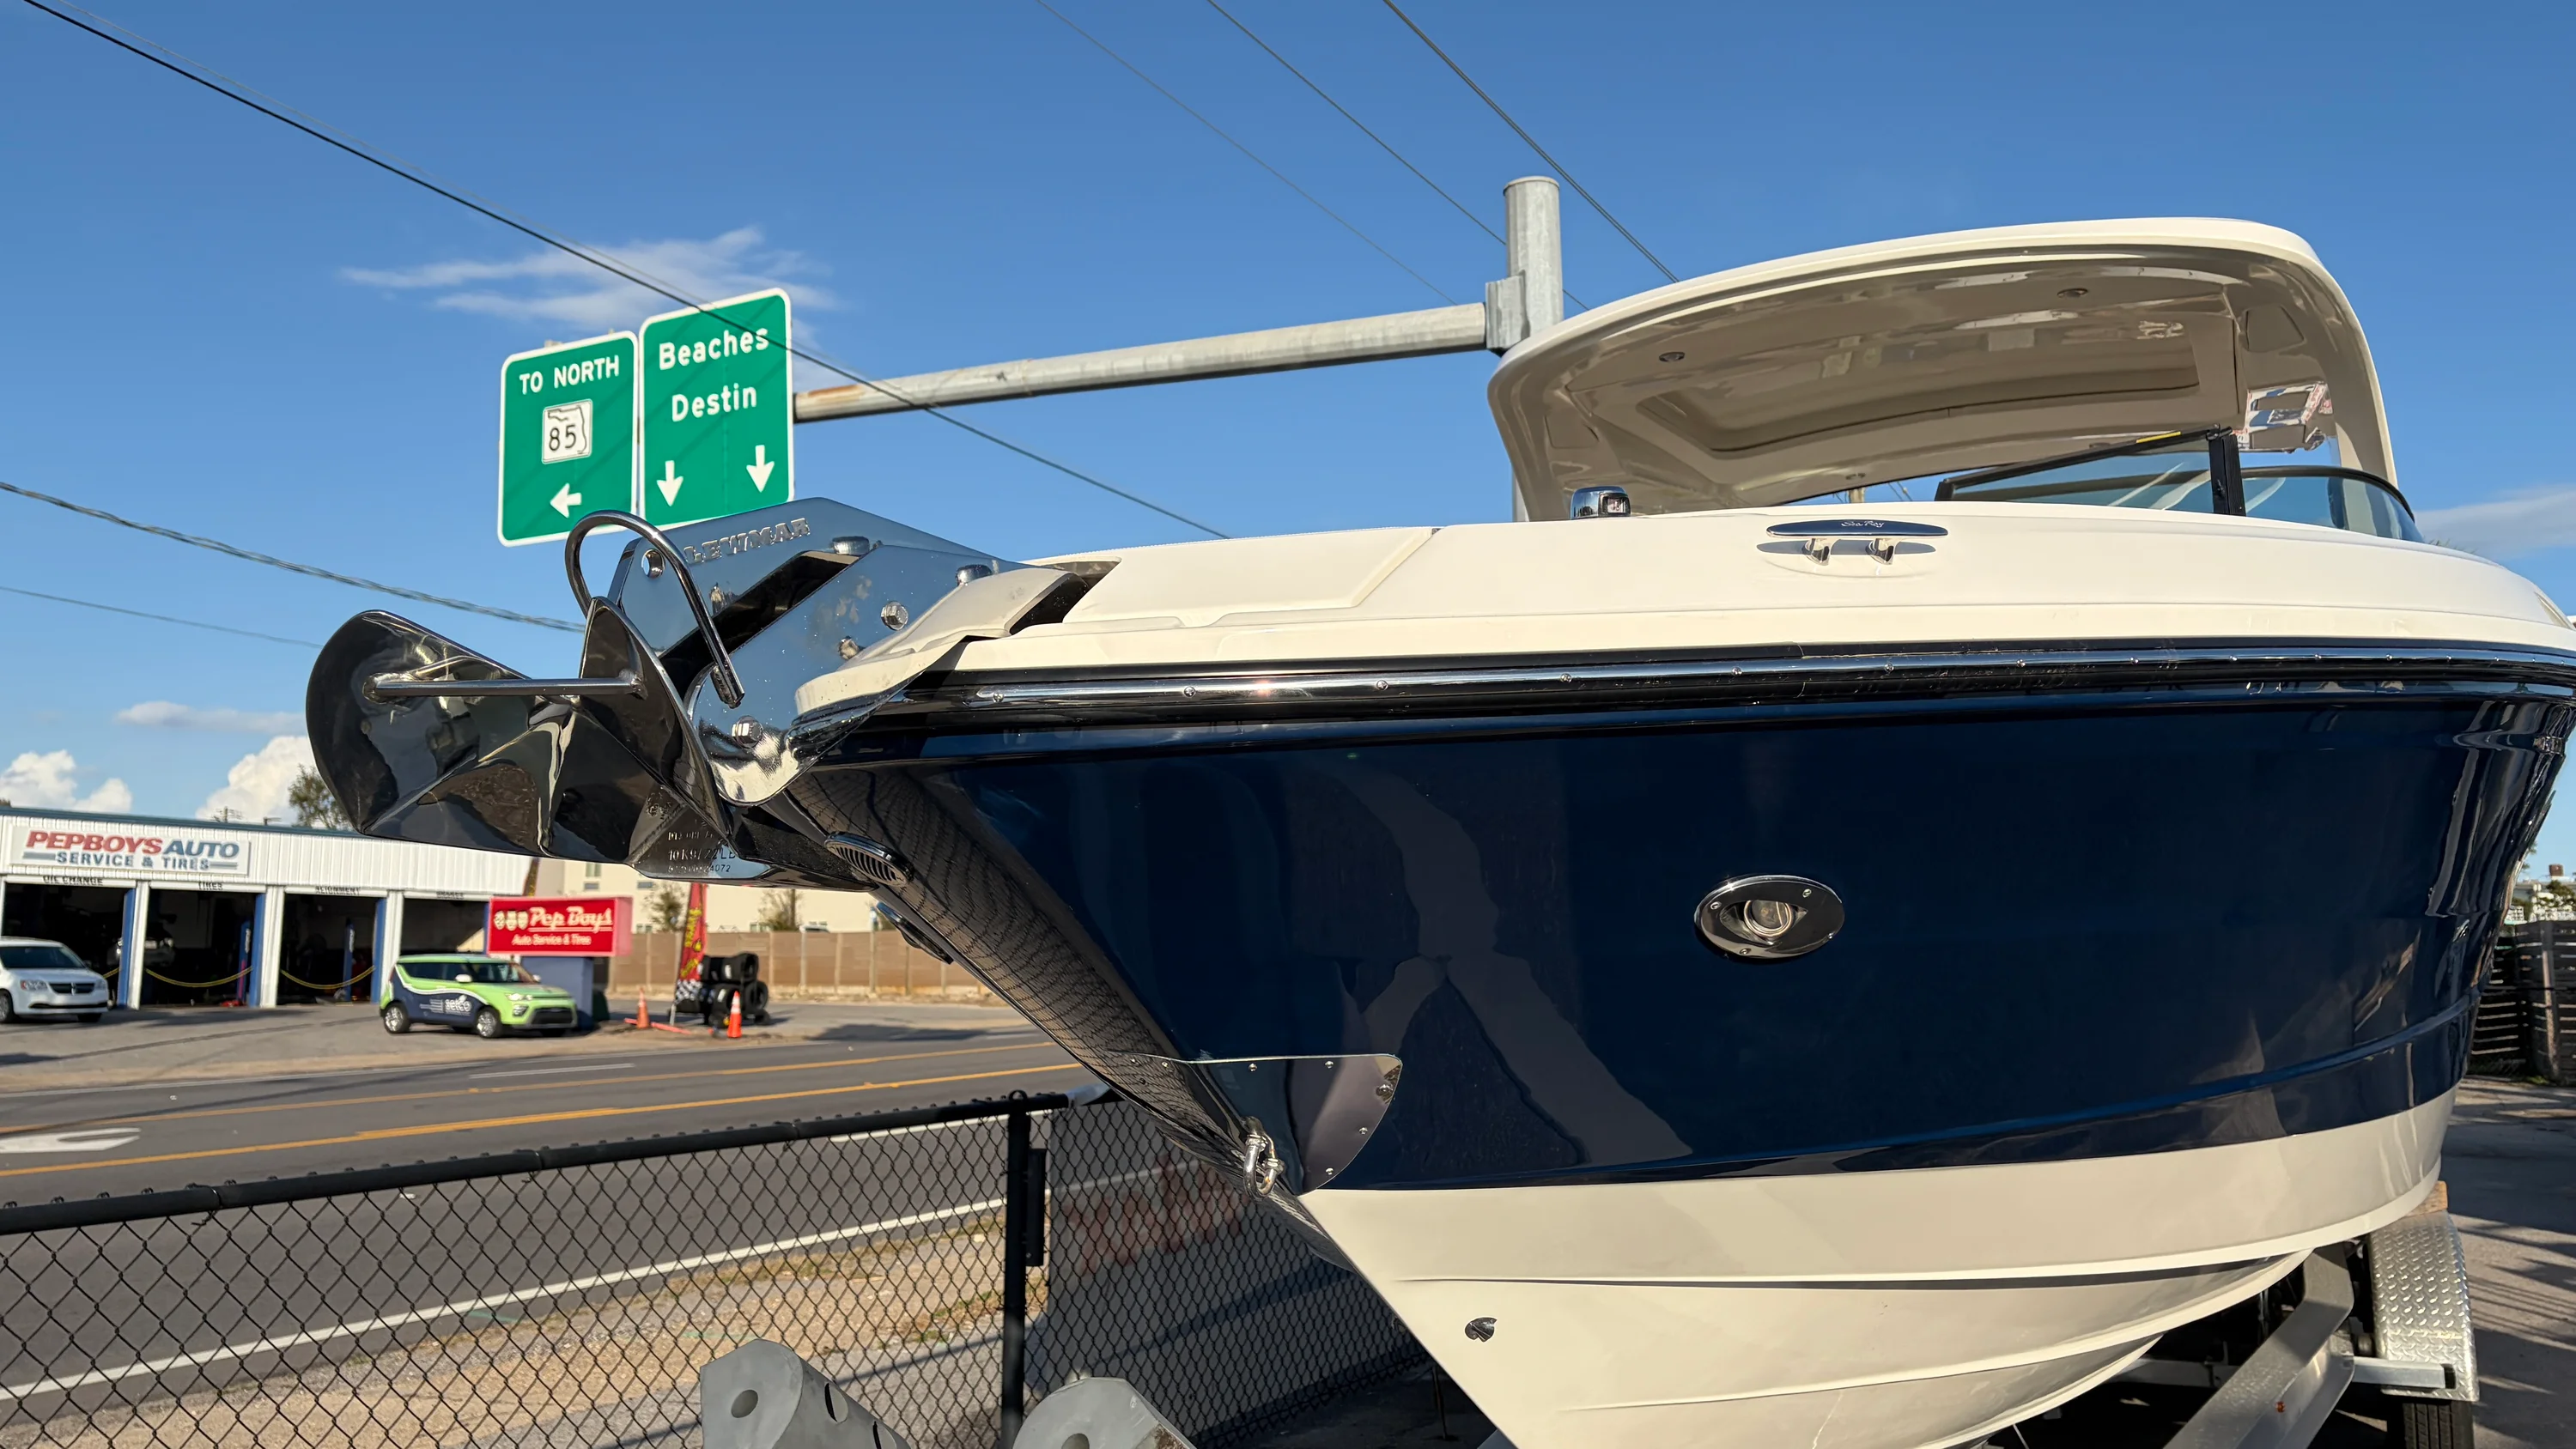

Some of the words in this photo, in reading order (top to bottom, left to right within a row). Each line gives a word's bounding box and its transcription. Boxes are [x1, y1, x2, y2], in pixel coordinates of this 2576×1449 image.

[659, 327, 769, 370] Beaches
[519, 371, 544, 395] TO
[554, 355, 620, 389] NORTH
[671, 383, 757, 421] Destin
[548, 424, 577, 452] 85
[683, 518, 811, 565] LEWMAR
[26, 831, 163, 855] PEPBOYS
[163, 840, 240, 858] AUTO
[56, 851, 134, 867] SERVICE
[142, 857, 153, 868] &
[163, 858, 210, 871] TIRES
[43, 876, 60, 885] OIL
[62, 876, 103, 887] CHANGE
[530, 906, 566, 931] Pep
[567, 906, 614, 933] Boys
